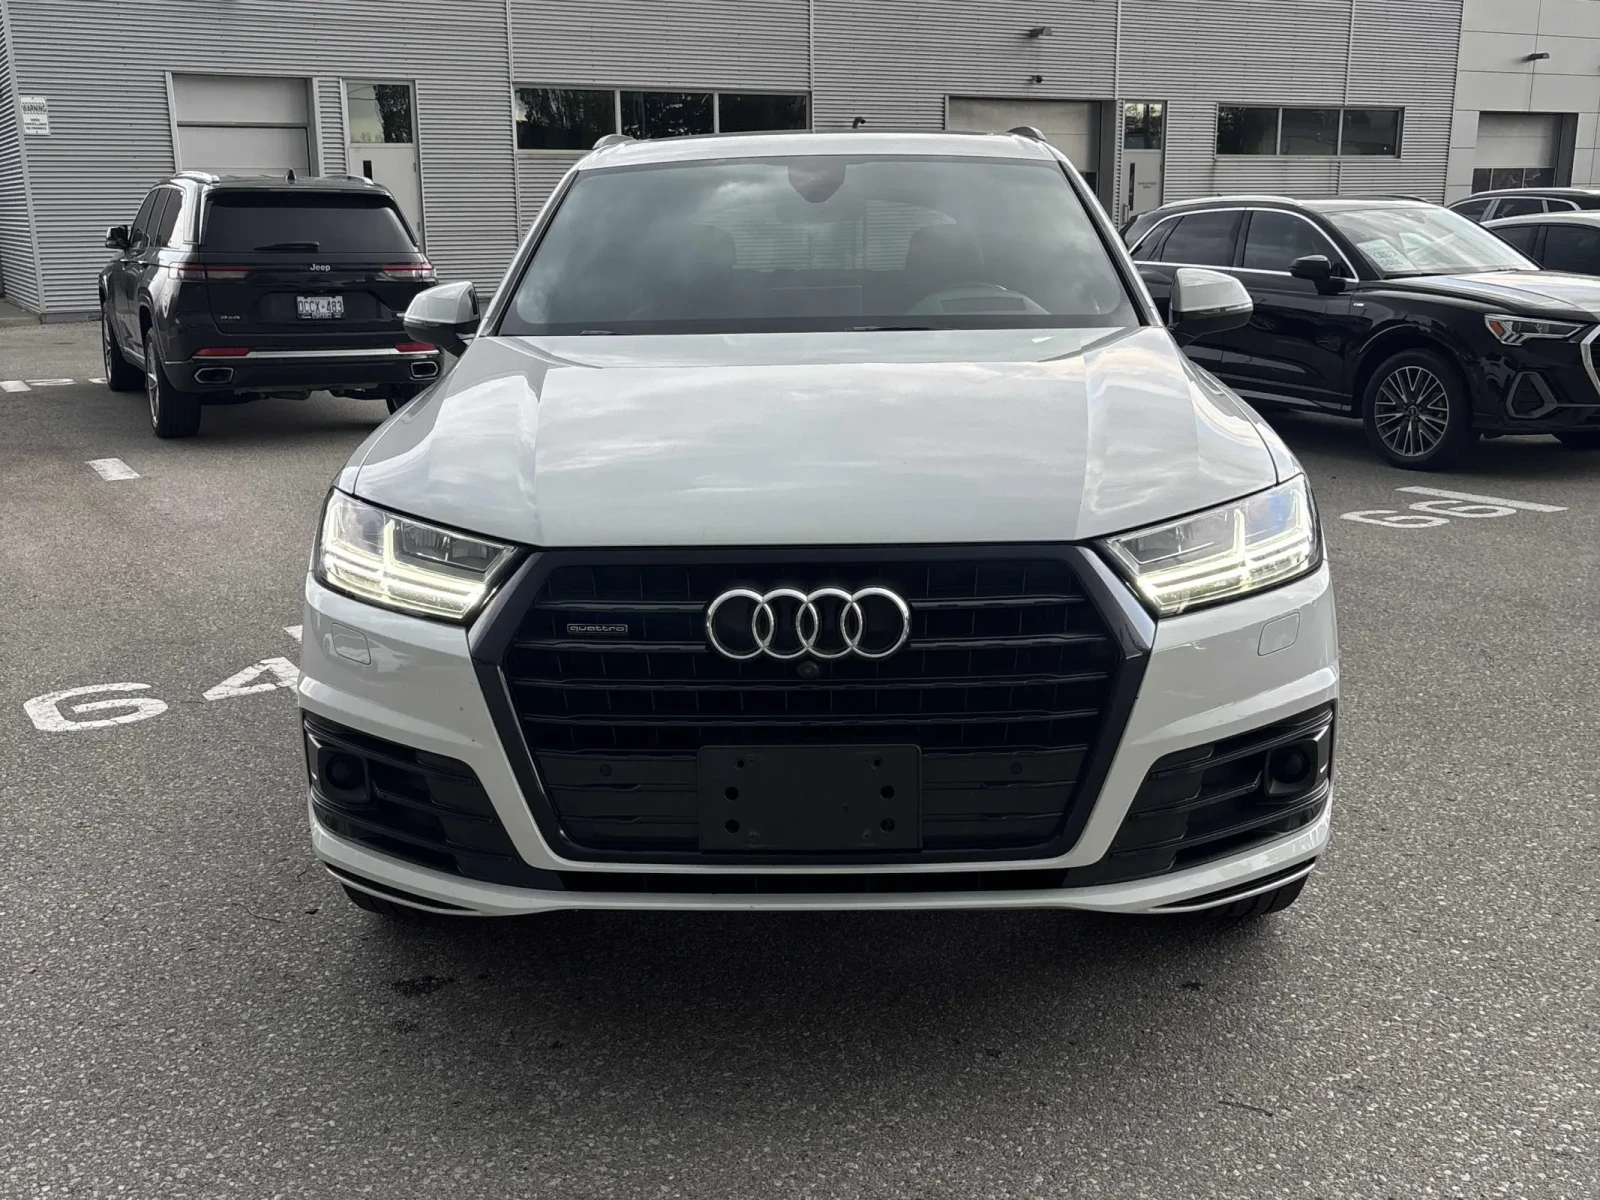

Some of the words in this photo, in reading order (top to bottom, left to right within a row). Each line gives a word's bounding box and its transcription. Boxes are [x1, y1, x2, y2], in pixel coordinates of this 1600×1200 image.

[21, 103, 47, 112] WARNING
[310, 263, 330, 272] Jeep
[1340, 500, 1517, 529] 66
